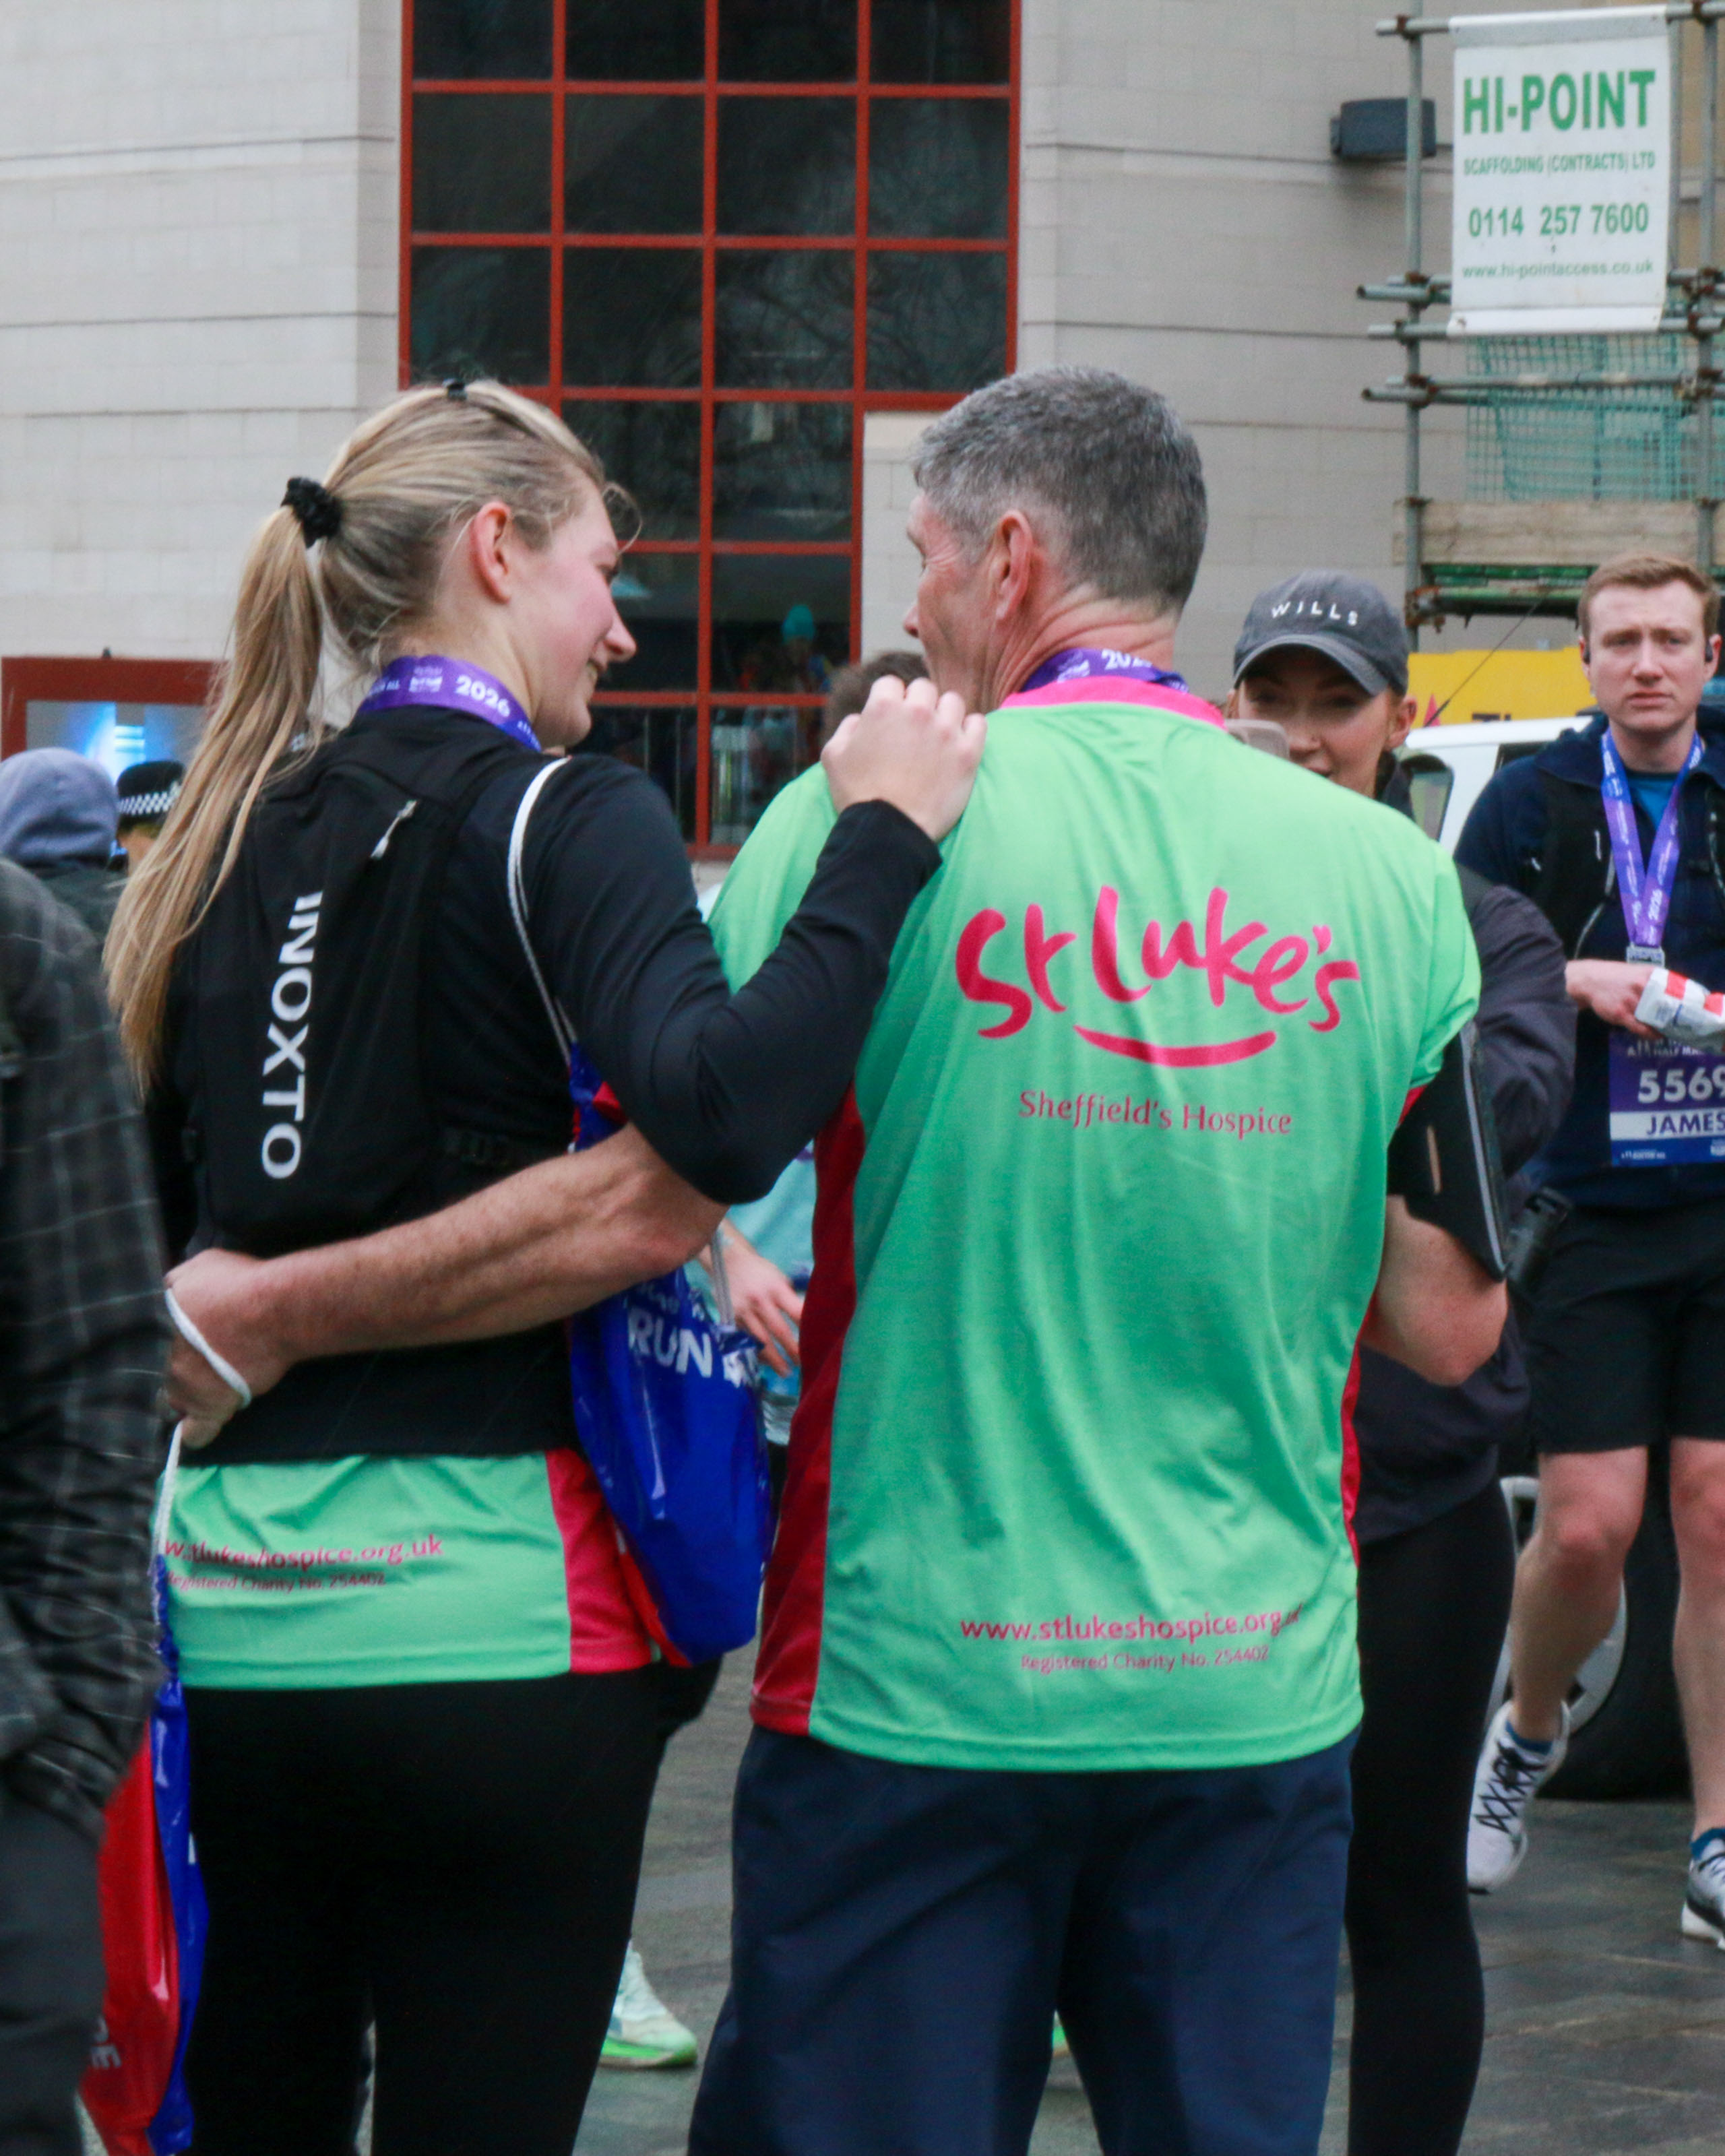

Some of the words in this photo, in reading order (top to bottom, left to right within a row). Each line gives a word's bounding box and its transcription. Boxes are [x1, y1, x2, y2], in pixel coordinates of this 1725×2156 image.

[1462, 69, 1656, 135] HI-POINT
[1464, 155, 1544, 175] SCAFFOLDING
[1632, 150, 1656, 169] LTD
[1468, 207, 1524, 237] 0114
[1540, 205, 1581, 236] 257
[1591, 202, 1650, 233] 7600
[1271, 600, 1358, 627] WILLS
[454, 675, 511, 718] 2026
[955, 903, 1077, 1040] St
[261, 891, 323, 1180] INOXTO
[1019, 1089, 1172, 1128] Sheffield's
[1182, 1104, 1292, 1140] Hospice
[1021, 1654, 1108, 1676] Registered
[1112, 1652, 1177, 1672] Charity
[1181, 1651, 1210, 1668] No.
[1214, 1645, 1270, 1666] 254402
